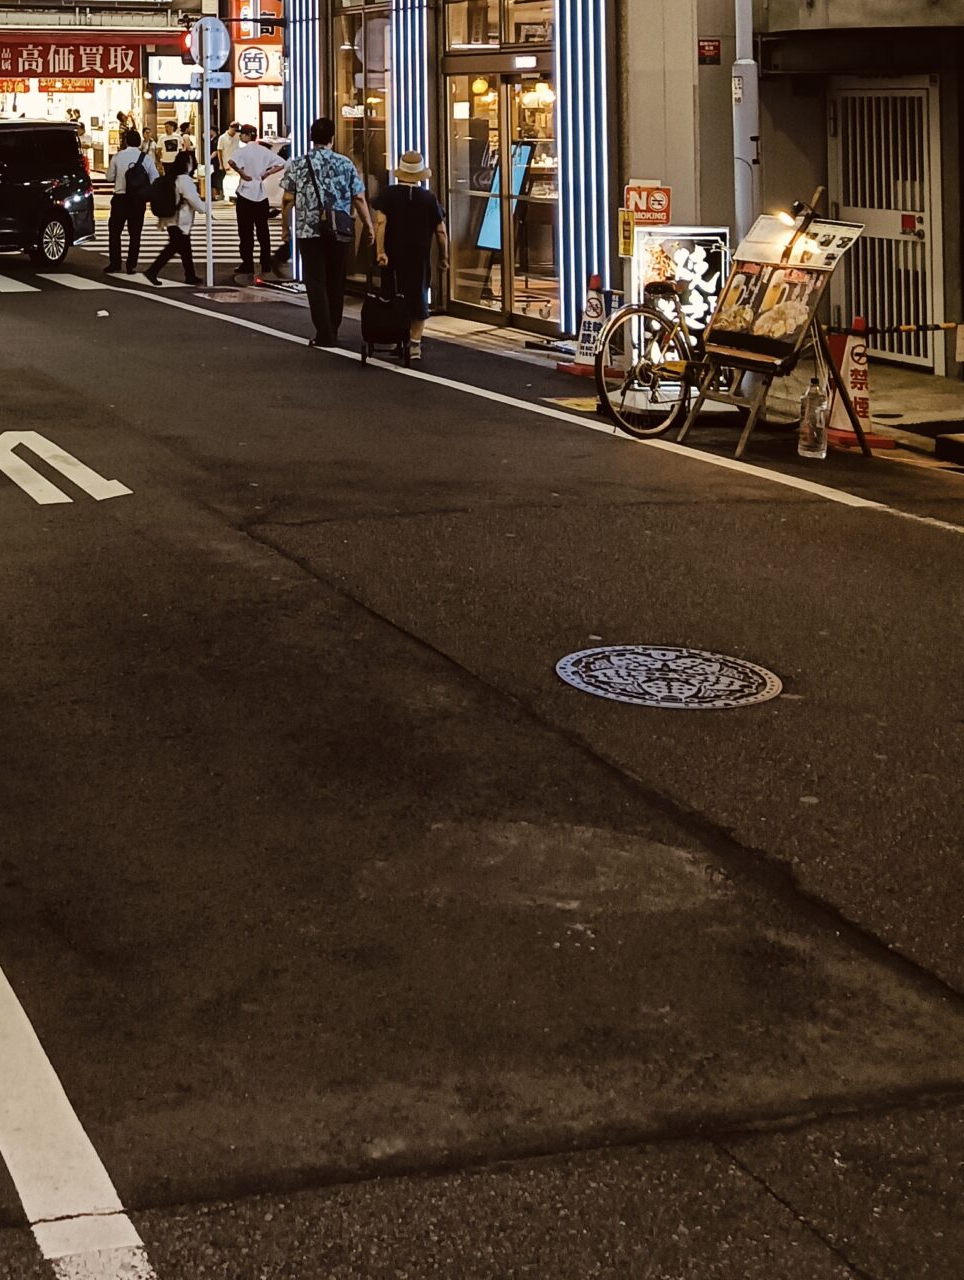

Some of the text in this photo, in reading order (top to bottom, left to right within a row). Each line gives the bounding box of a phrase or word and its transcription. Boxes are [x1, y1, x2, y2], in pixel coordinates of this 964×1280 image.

[18, 44, 135, 73] 高価買取
[243, 53, 264, 75] 質
